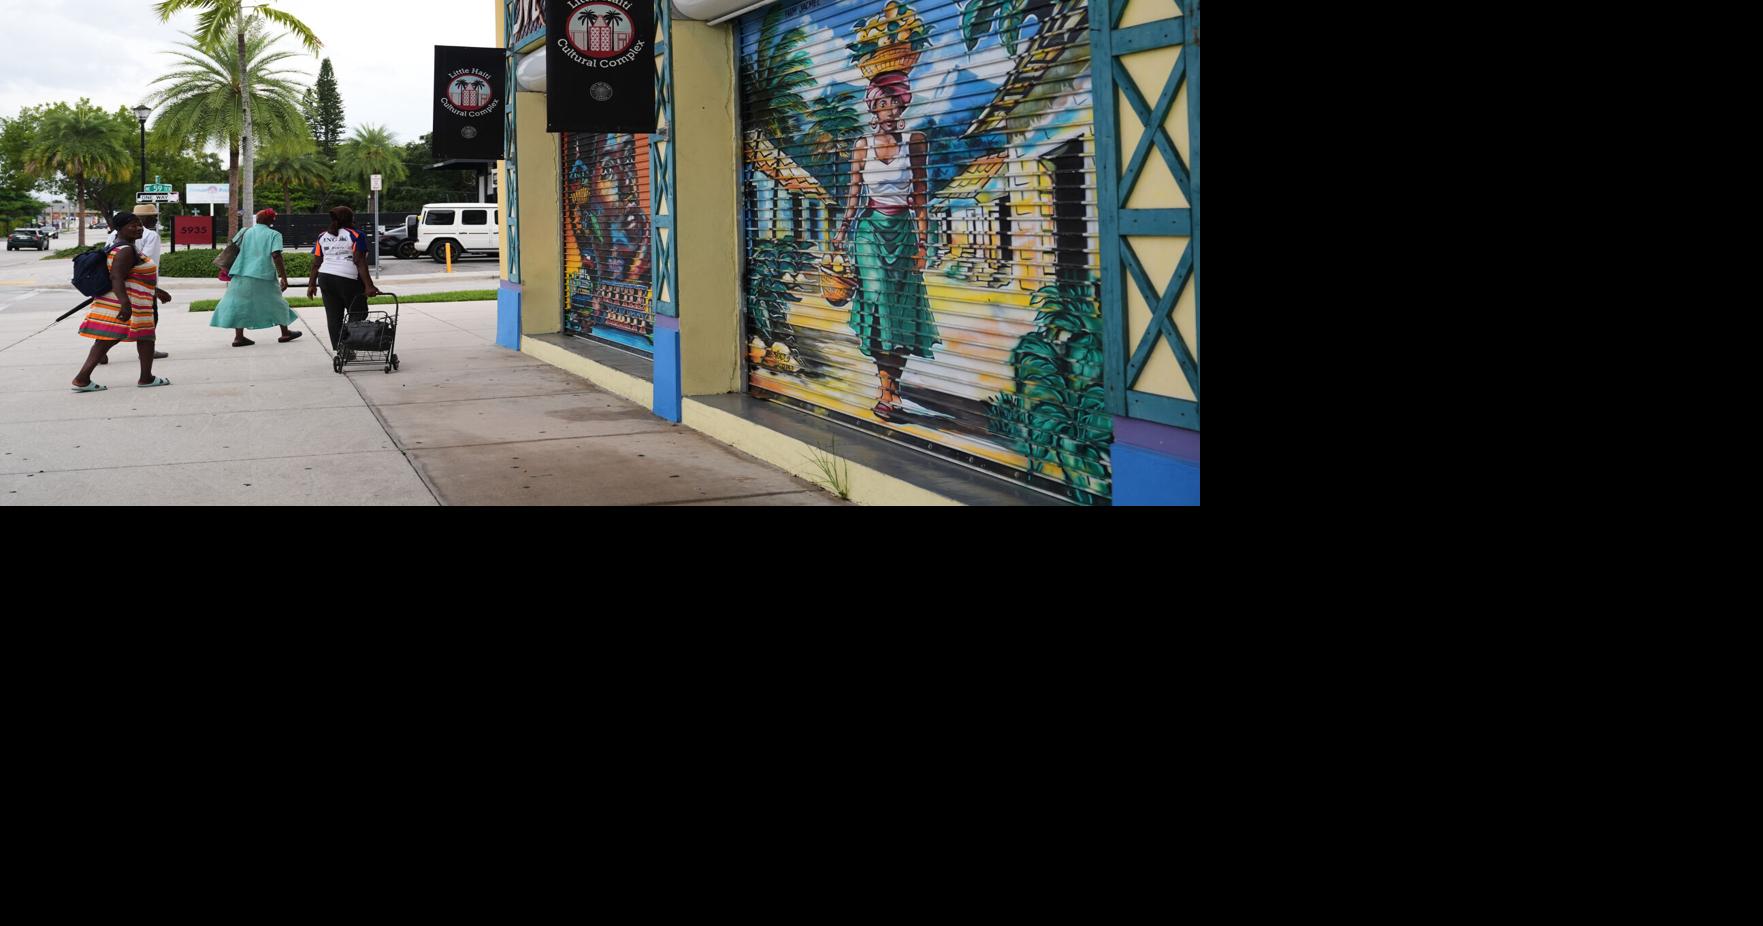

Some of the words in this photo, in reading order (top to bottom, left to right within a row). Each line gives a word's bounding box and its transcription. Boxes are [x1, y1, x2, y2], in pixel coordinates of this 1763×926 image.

[557, 38, 597, 68] Cultural
[599, 39, 646, 69] Complex
[448, 67, 470, 79] Little
[471, 67, 492, 80] Haiti
[440, 97, 467, 117] Cultural
[468, 98, 499, 118] Complex
[181, 226, 207, 234] 5935
